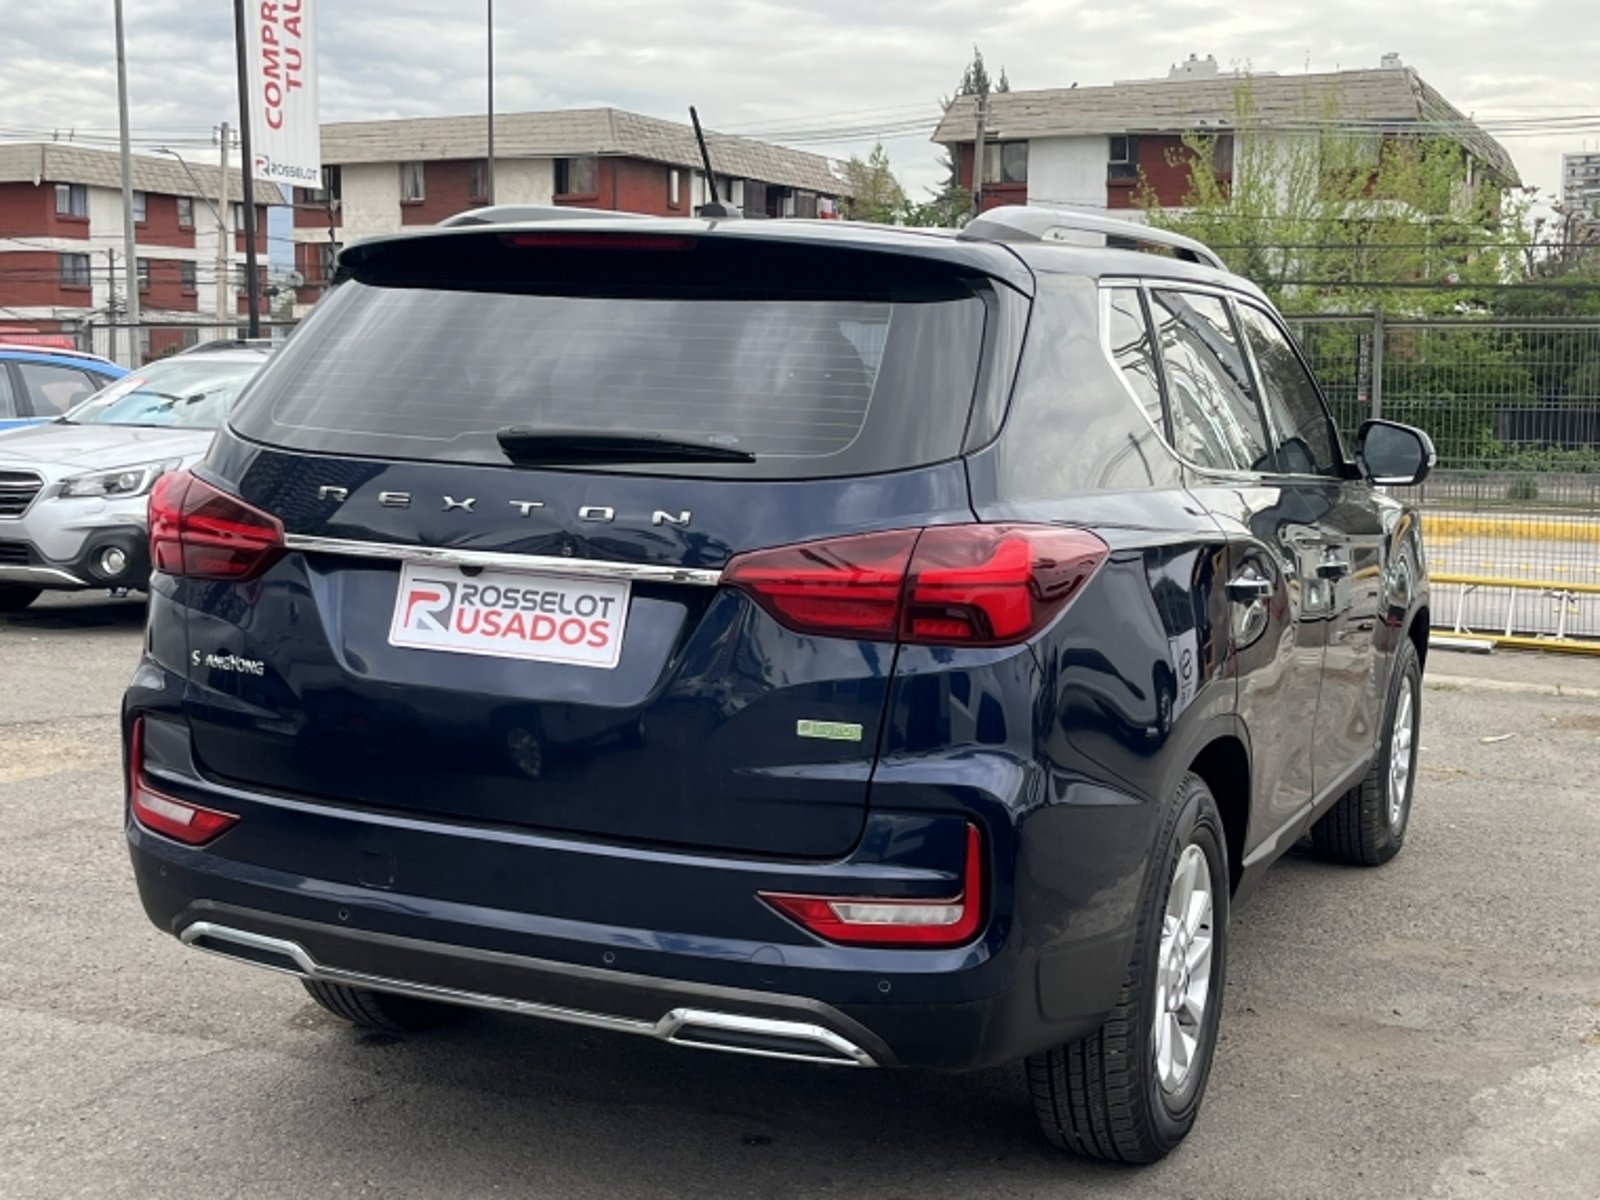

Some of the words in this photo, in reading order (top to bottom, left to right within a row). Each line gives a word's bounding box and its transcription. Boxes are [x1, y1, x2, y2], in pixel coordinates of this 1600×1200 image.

[260, 0, 283, 130] COMPR
[284, 48, 303, 93] TU
[318, 485, 692, 527] REXTON
[460, 583, 615, 618] ROSSELOT
[456, 608, 610, 648] USADOS
